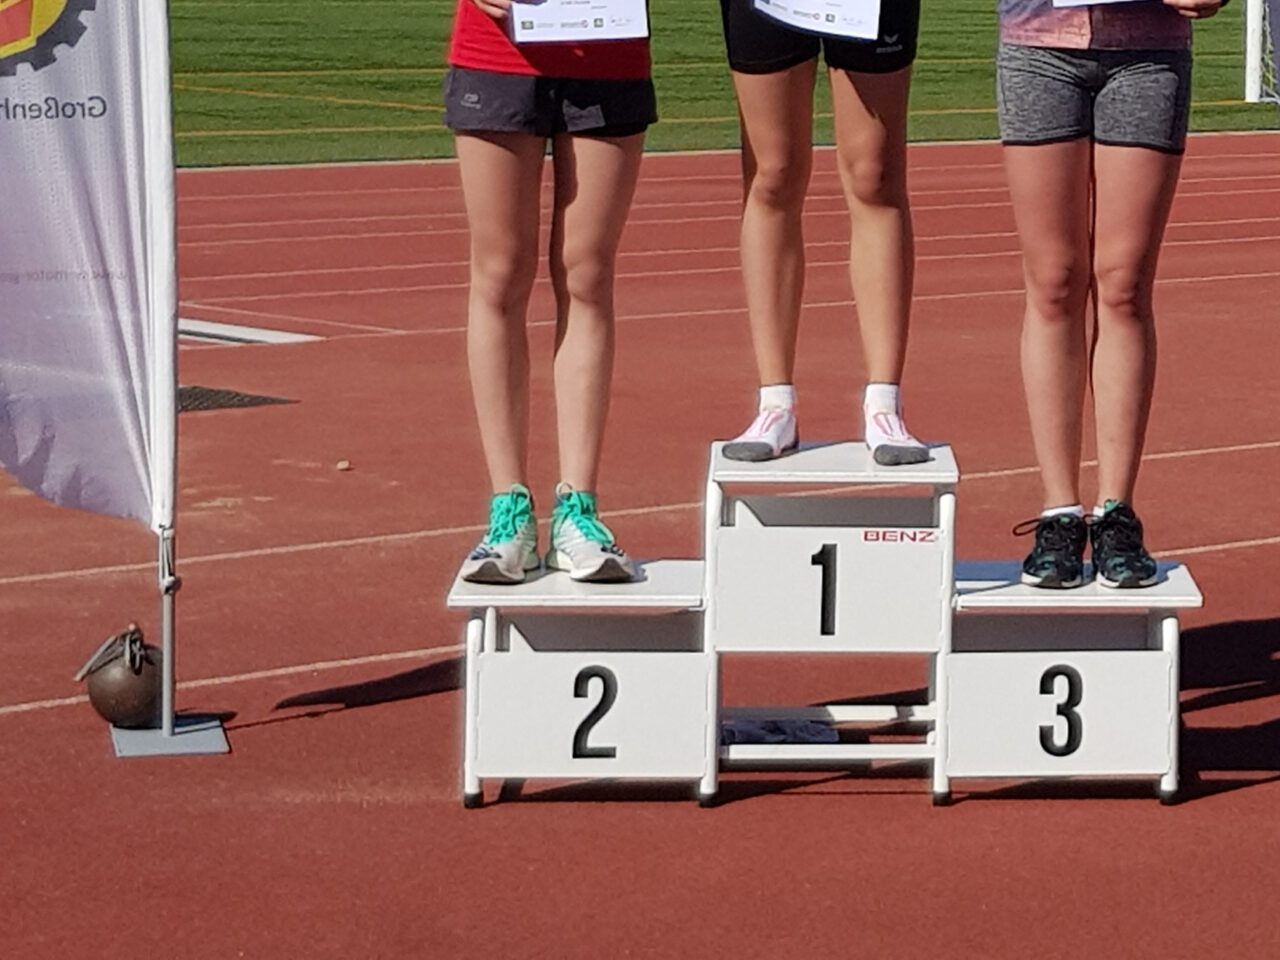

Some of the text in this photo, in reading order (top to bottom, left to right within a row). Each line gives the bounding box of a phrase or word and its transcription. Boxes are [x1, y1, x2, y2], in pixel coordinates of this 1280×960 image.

[864, 530, 934, 543] BENZ
[810, 543, 837, 636] 1
[571, 664, 618, 759] 2
[1038, 664, 1084, 757] 3
